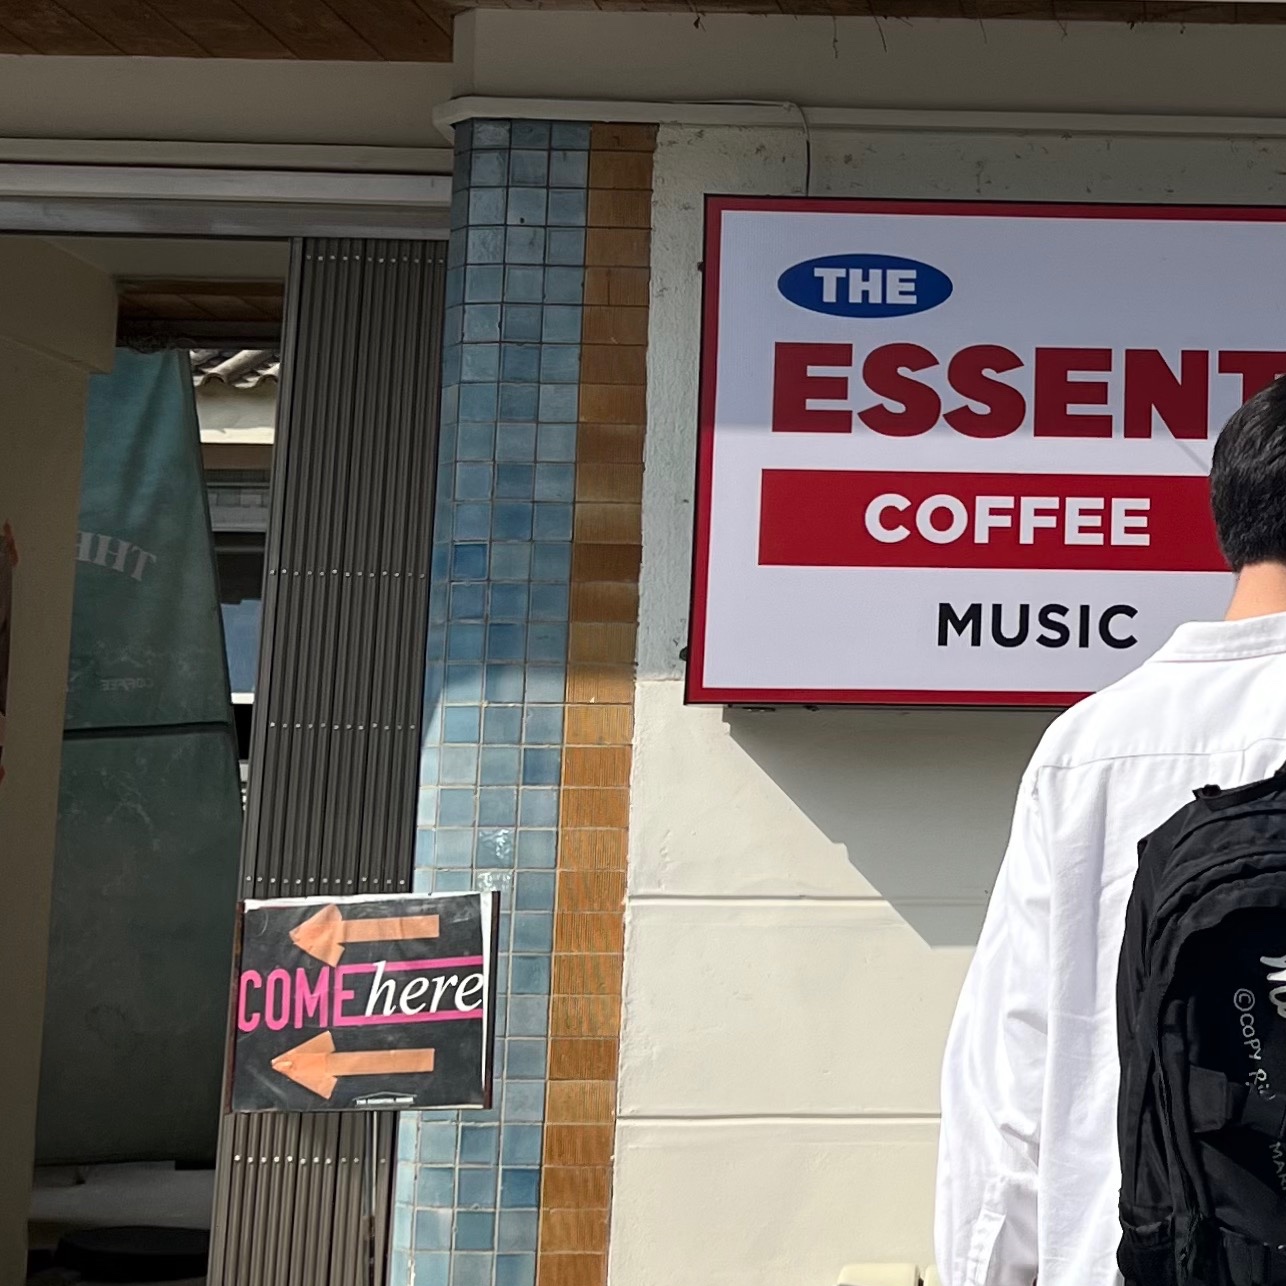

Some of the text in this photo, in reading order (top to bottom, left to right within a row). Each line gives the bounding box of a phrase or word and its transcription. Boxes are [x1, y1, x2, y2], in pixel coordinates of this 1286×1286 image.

[813, 267, 918, 305] THE
[864, 493, 1151, 546] COFFEE
[936, 602, 1139, 650] MUSIC
[237, 959, 485, 1033] COME here
